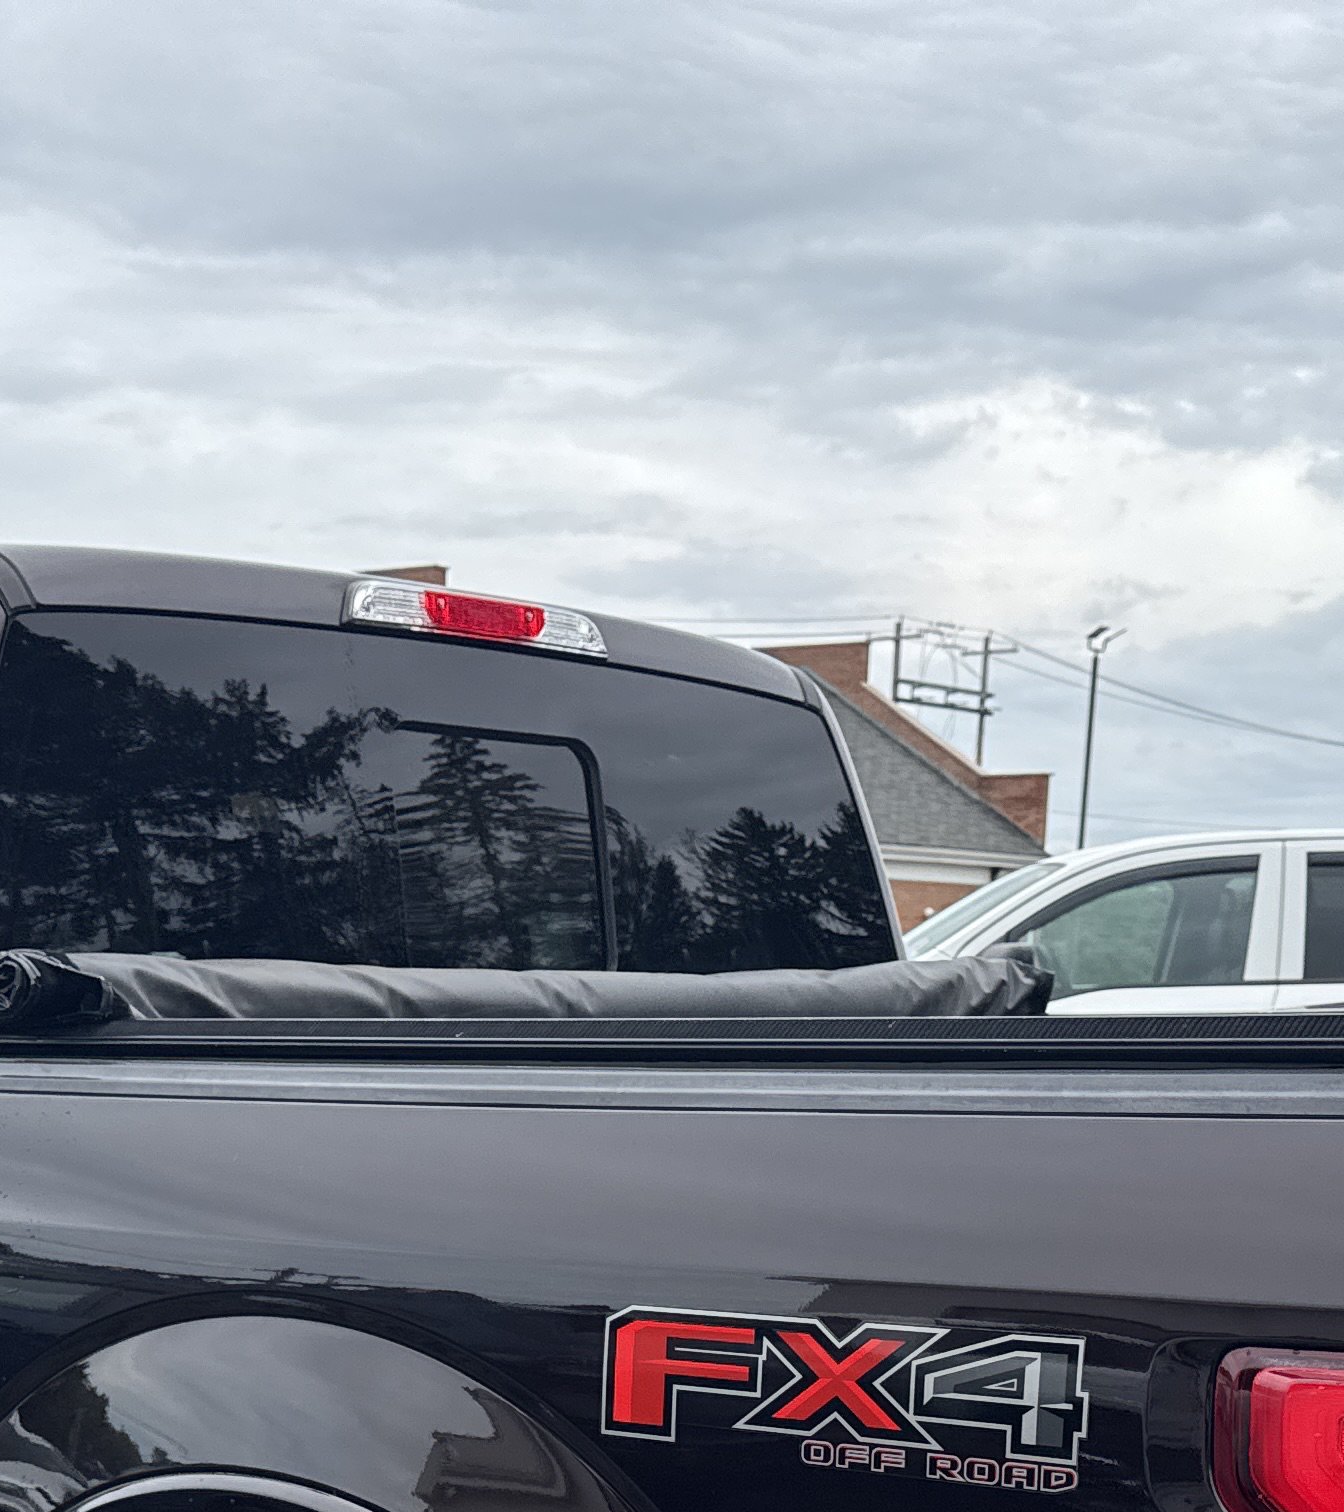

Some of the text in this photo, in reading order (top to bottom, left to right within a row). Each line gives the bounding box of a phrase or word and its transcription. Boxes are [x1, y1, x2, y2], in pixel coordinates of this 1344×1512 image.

[601, 1305, 1088, 1465] FX4
[800, 1440, 1079, 1493] OFF ROAD
